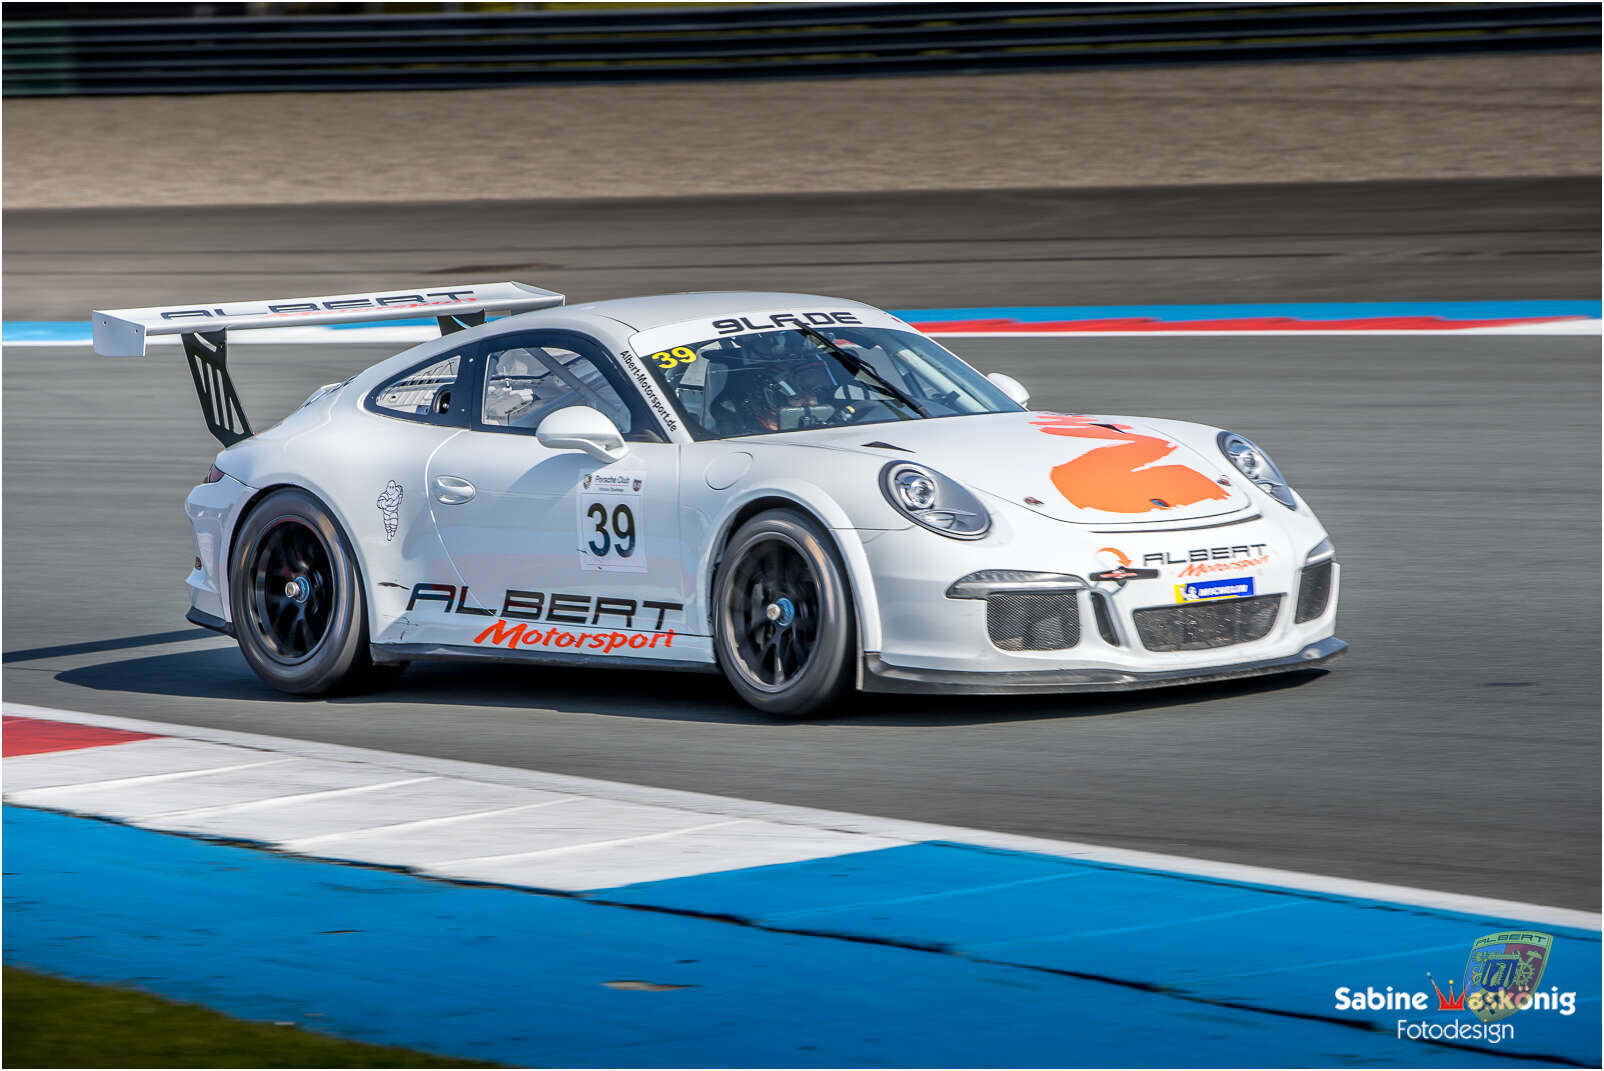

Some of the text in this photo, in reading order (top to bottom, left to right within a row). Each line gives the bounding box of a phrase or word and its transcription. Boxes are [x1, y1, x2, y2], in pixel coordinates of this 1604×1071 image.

[160, 290, 475, 321] ALBERT
[652, 346, 696, 369] 39
[620, 350, 677, 432] Albert-Motorsport.de
[587, 503, 636, 558] 39
[1143, 543, 1267, 566] ALBERT
[406, 583, 684, 630] ALBERT
[473, 619, 674, 654] Motorsport
